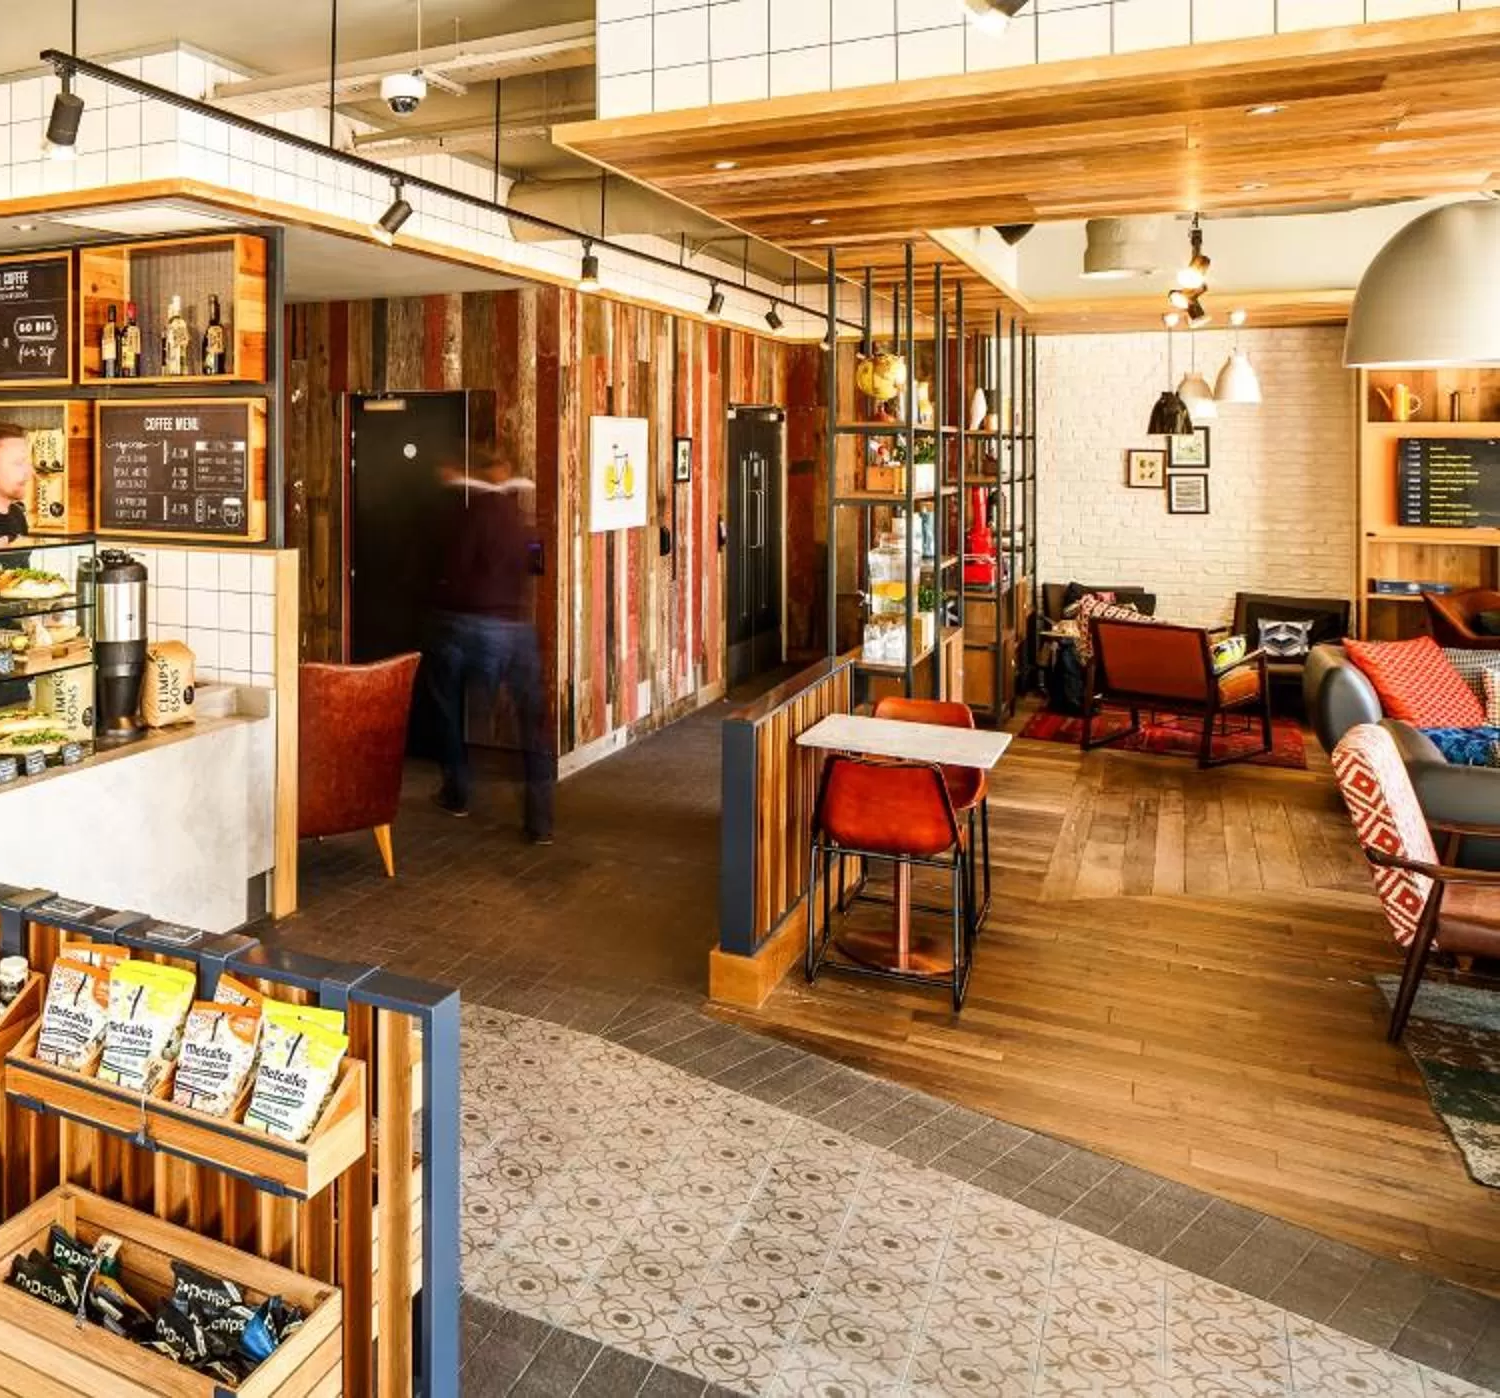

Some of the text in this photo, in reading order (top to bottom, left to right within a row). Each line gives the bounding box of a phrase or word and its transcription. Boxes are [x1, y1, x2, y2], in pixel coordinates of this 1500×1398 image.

[3, 271, 28, 285] COFFEE
[18, 321, 52, 333] GO BIG
[143, 417, 200, 431] COFFEE MENU
[157, 655, 169, 713] CLIMPS
